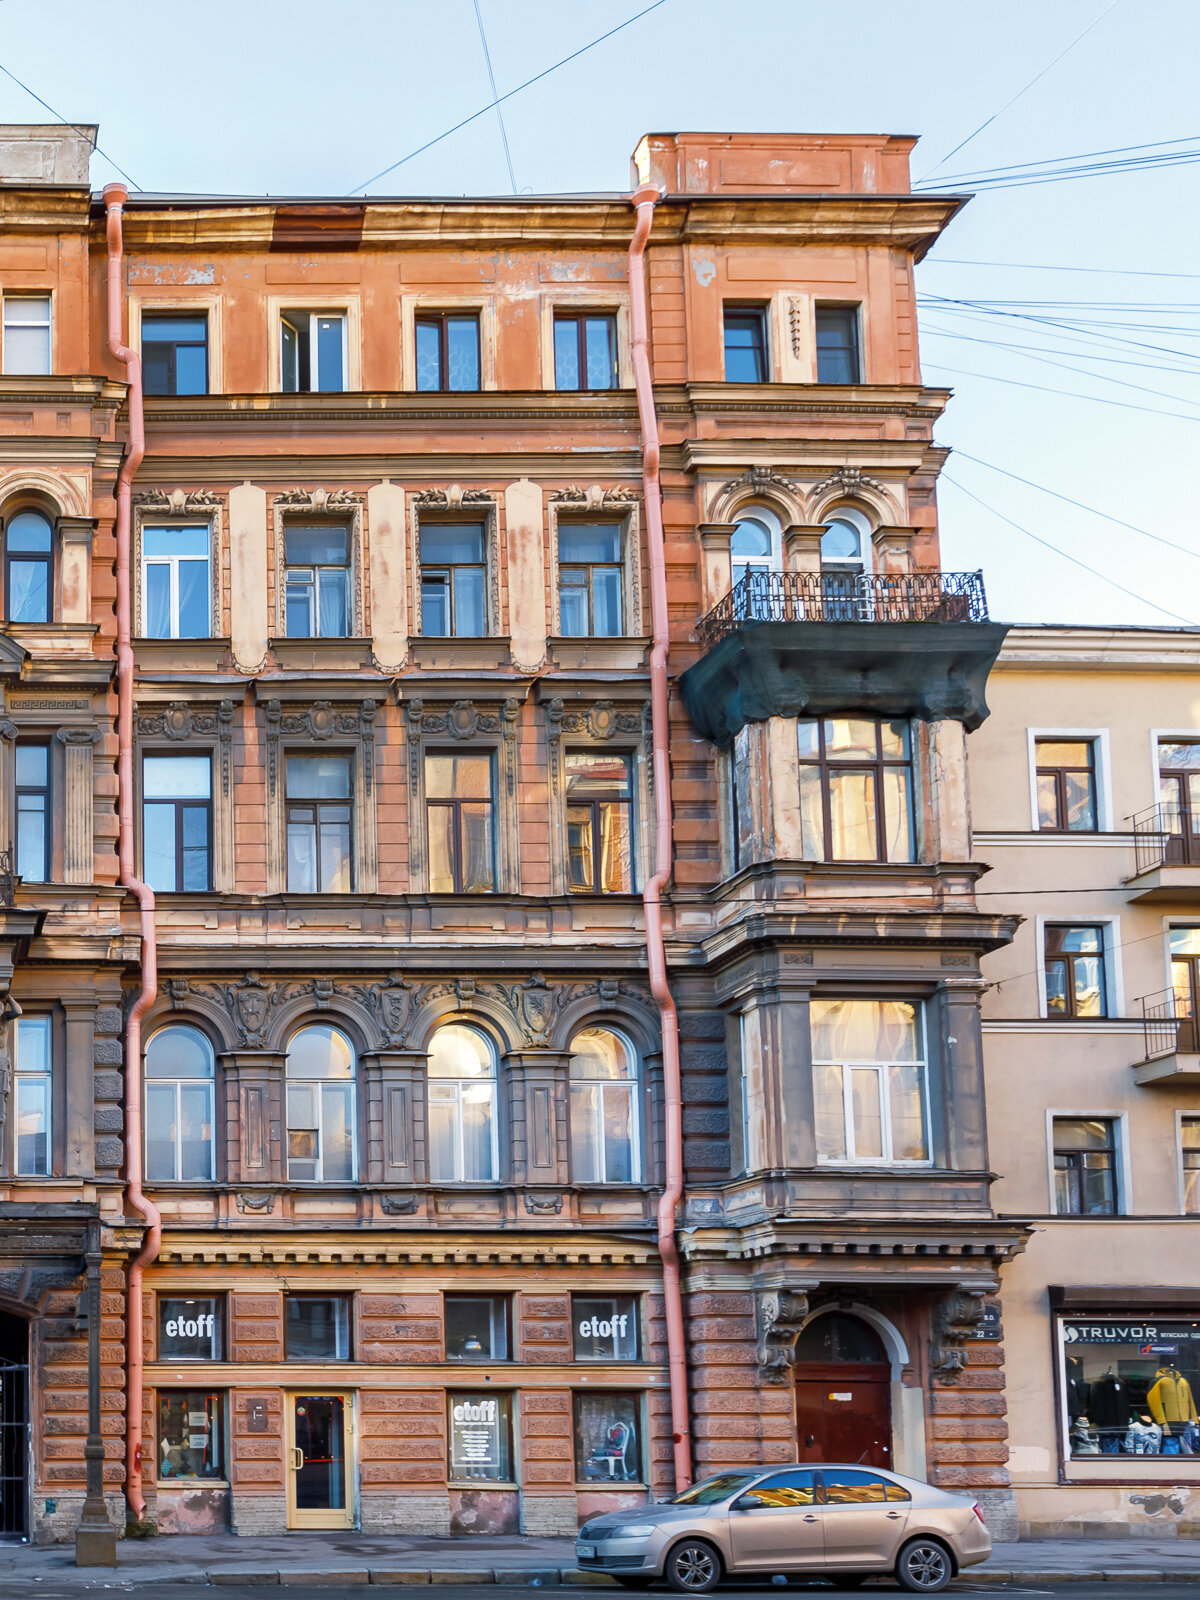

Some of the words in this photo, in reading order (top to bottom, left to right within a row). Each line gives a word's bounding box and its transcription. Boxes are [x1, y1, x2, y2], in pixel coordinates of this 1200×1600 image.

[166, 1314, 214, 1338] etoff
[579, 1314, 628, 1338] etoff
[977, 1330, 985, 1338] 22
[1079, 1327, 1157, 1338] TRUVOR
[454, 1401, 496, 1422] etoff
